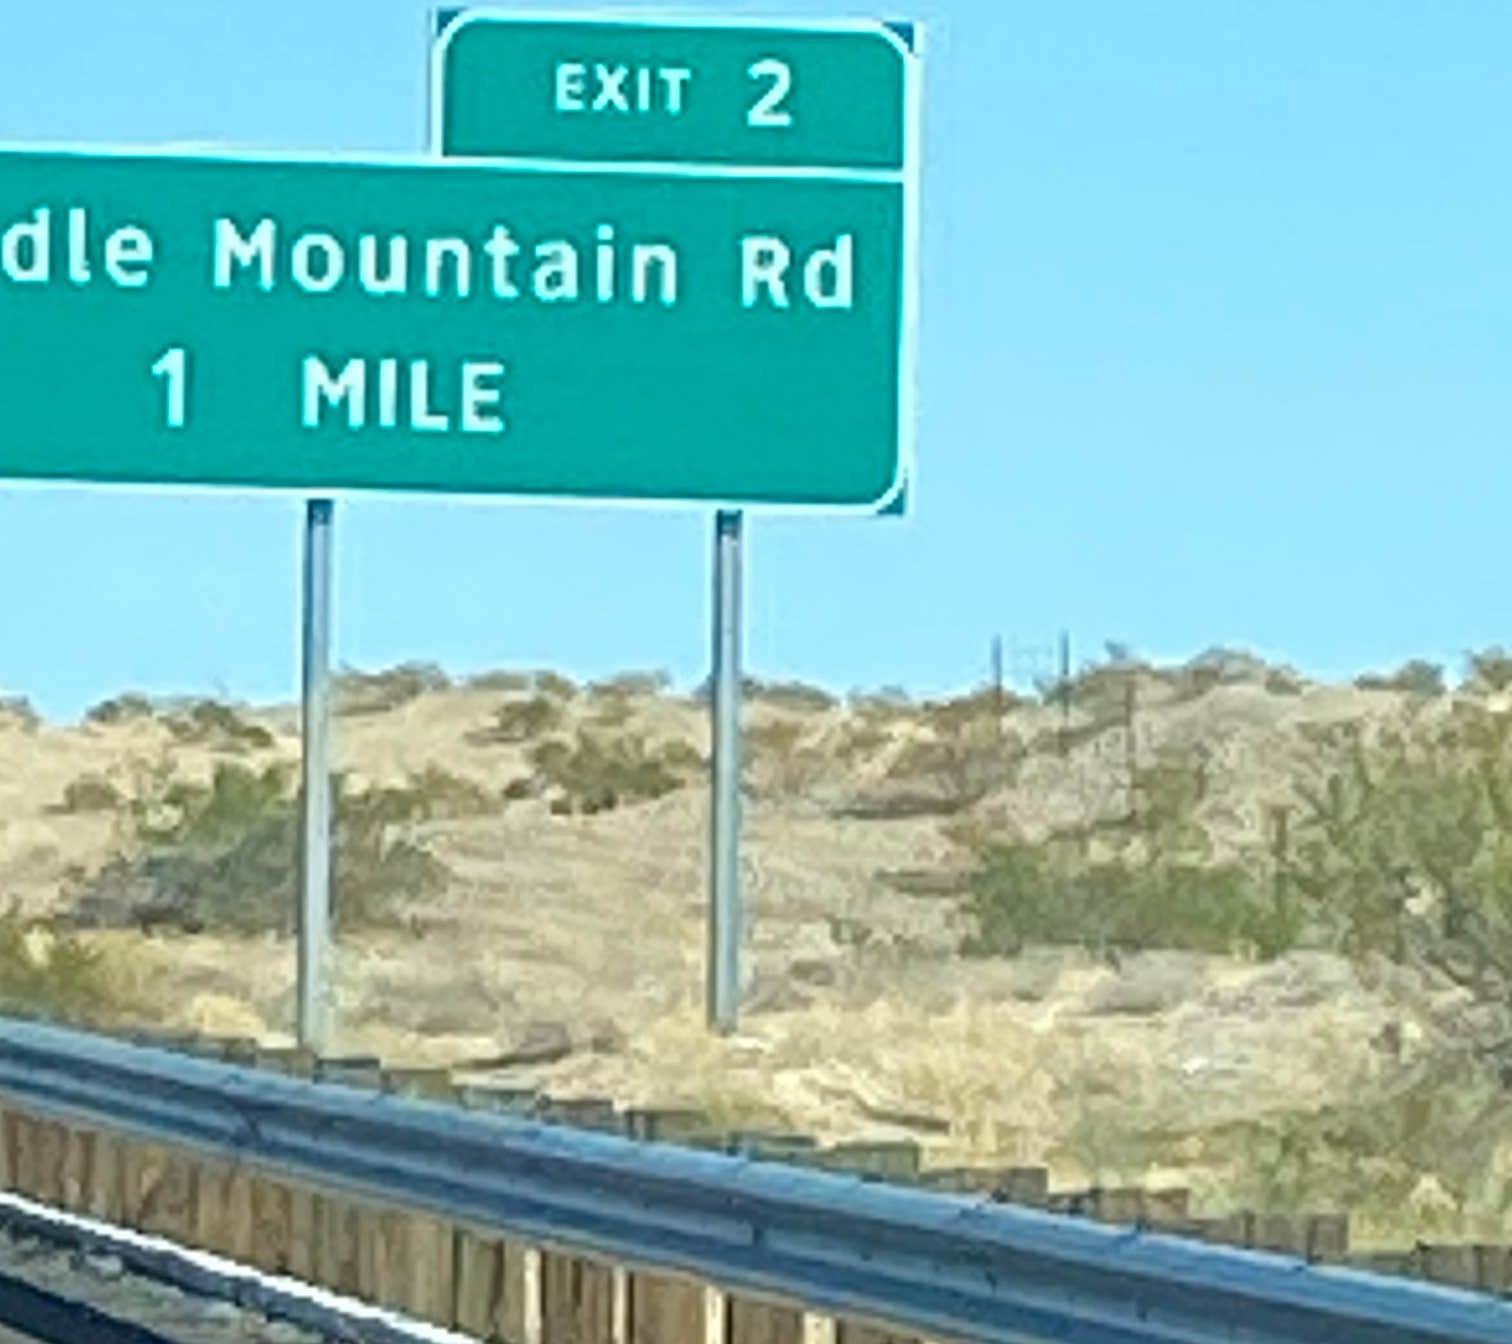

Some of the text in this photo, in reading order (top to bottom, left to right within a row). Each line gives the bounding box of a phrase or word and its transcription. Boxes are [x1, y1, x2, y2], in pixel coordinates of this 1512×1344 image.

[556, 58, 792, 126] EXIT 2
[212, 217, 680, 304] Mountain
[740, 234, 854, 309] Rd
[150, 347, 506, 434] 1 MILE
